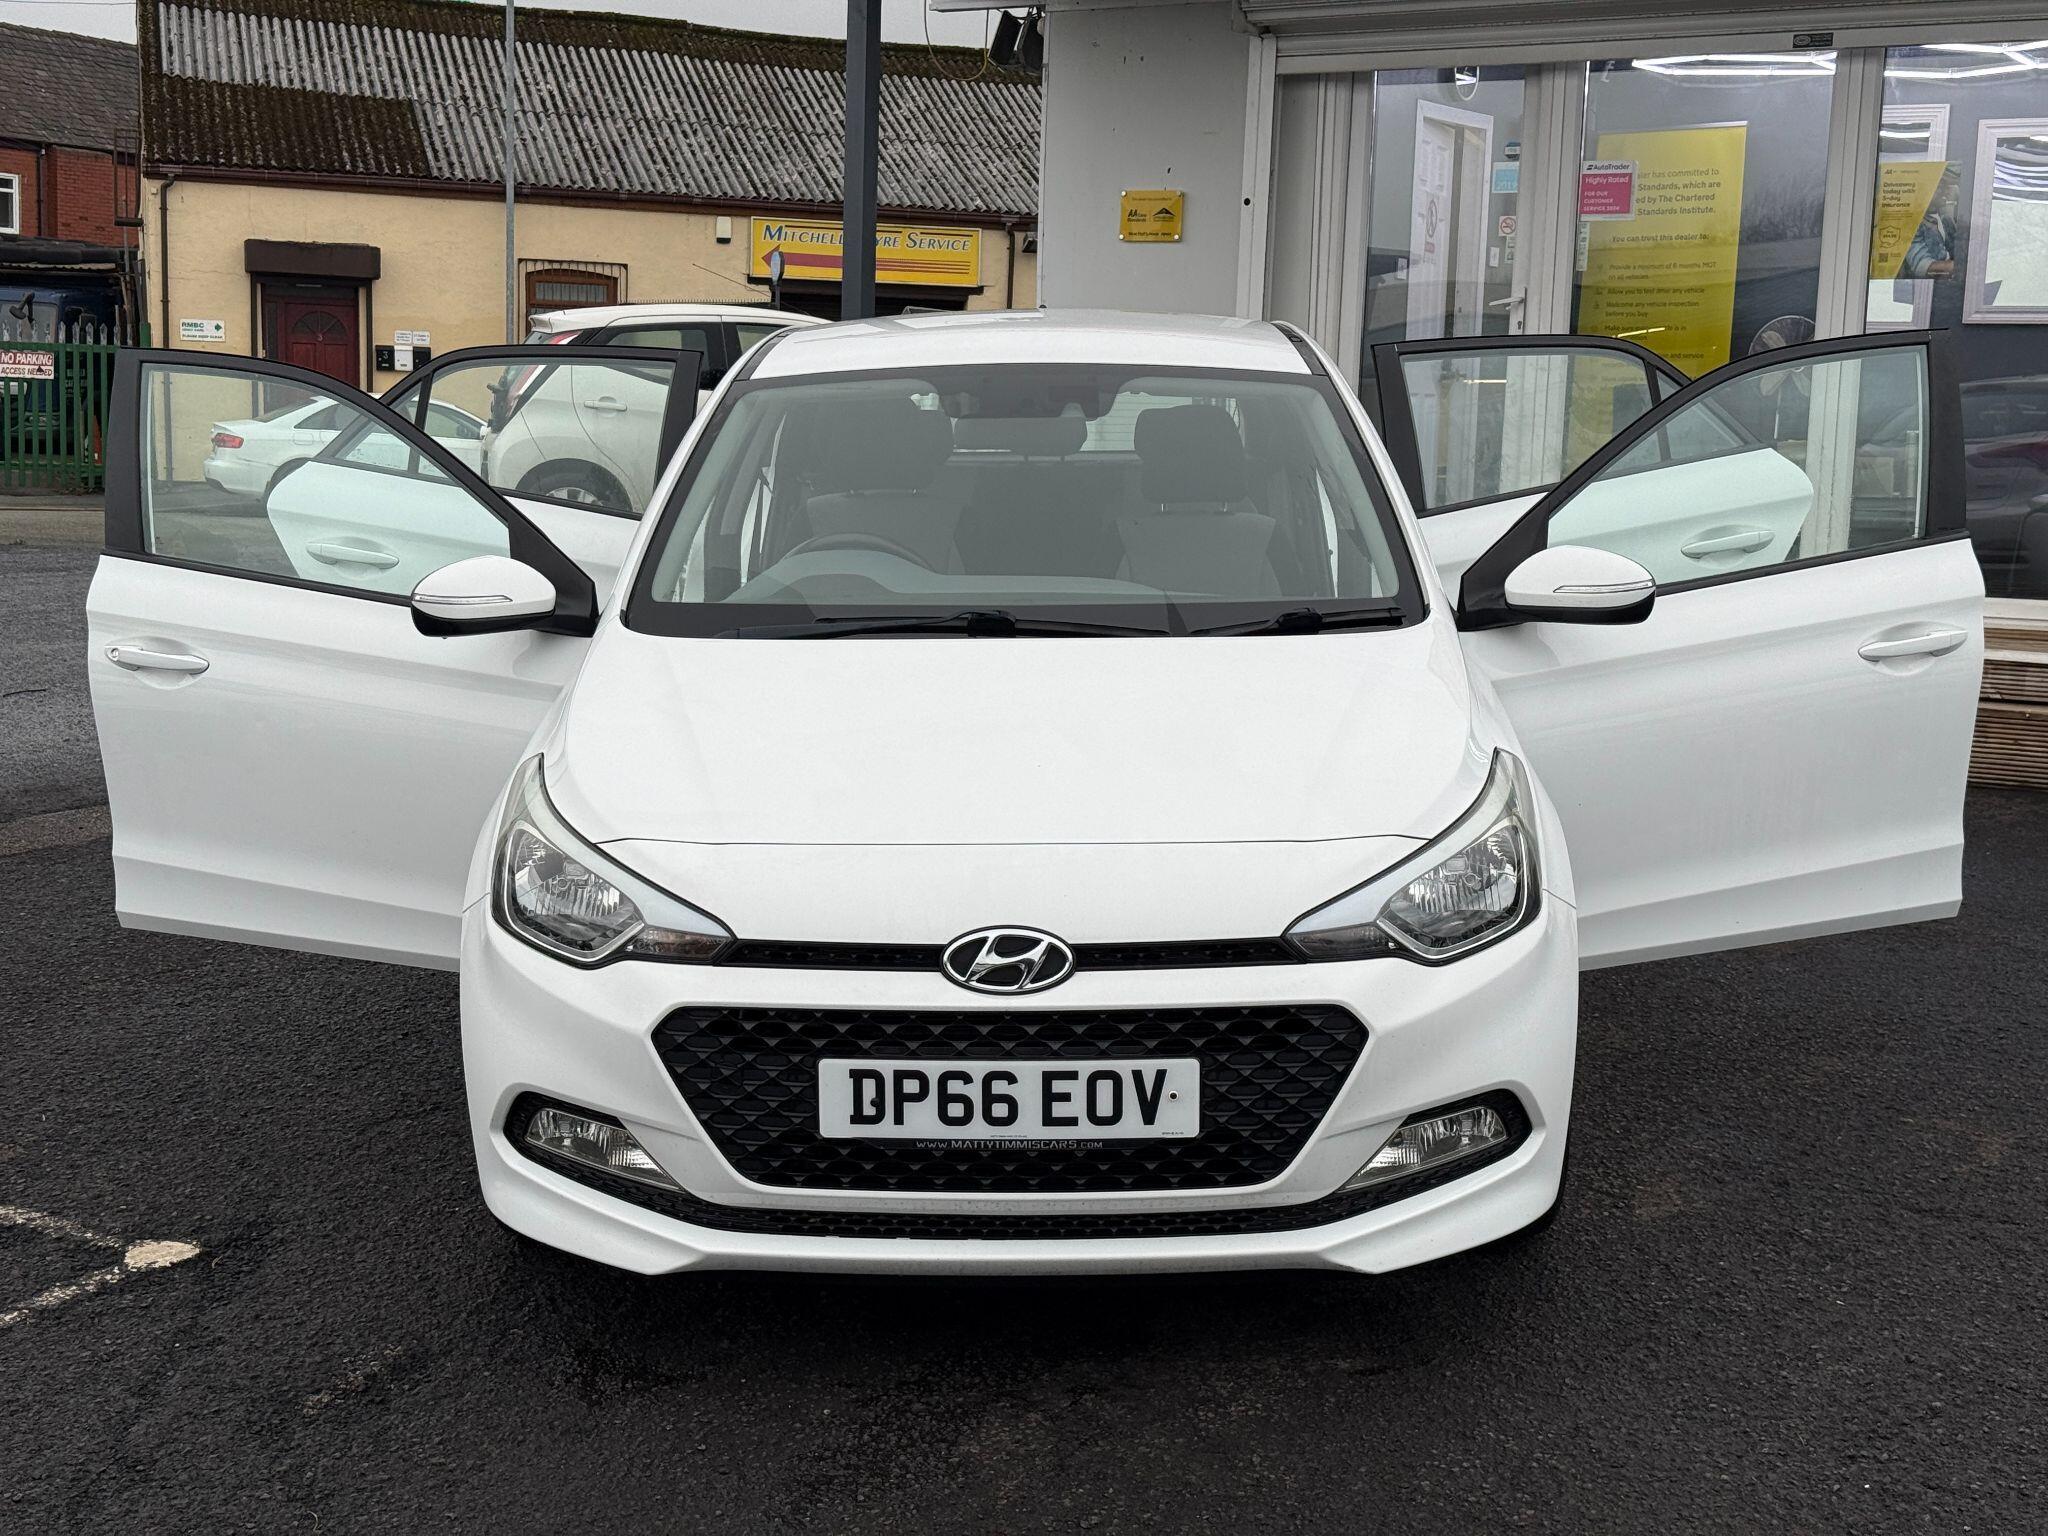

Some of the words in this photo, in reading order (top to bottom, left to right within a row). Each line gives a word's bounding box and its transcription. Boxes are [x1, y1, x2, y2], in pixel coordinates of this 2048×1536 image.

[1667, 168, 1709, 178] committed
[1711, 168, 1720, 176] to
[1585, 176, 1607, 185] Highly
[1638, 183, 1681, 192] Standards,
[1682, 181, 1707, 190] which
[1647, 197, 1657, 205] by
[1659, 194, 1673, 203] The
[1675, 193, 1716, 202] Chartered
[1637, 207, 1678, 216] Standards
[1679, 206, 1716, 214] Institute.
[875, 236, 900, 249] YRE
[906, 232, 970, 251] SERVICE
[1626, 234, 1640, 242] can
[1674, 232, 1698, 241] dealer
[1, 352, 15, 364] NO
[16, 353, 53, 366] PARKING
[383, 351, 389, 360] 3
[1, 366, 26, 376] ACCESS
[849, 1068, 1019, 1127] DP66
[1041, 1068, 1168, 1127] EOV
